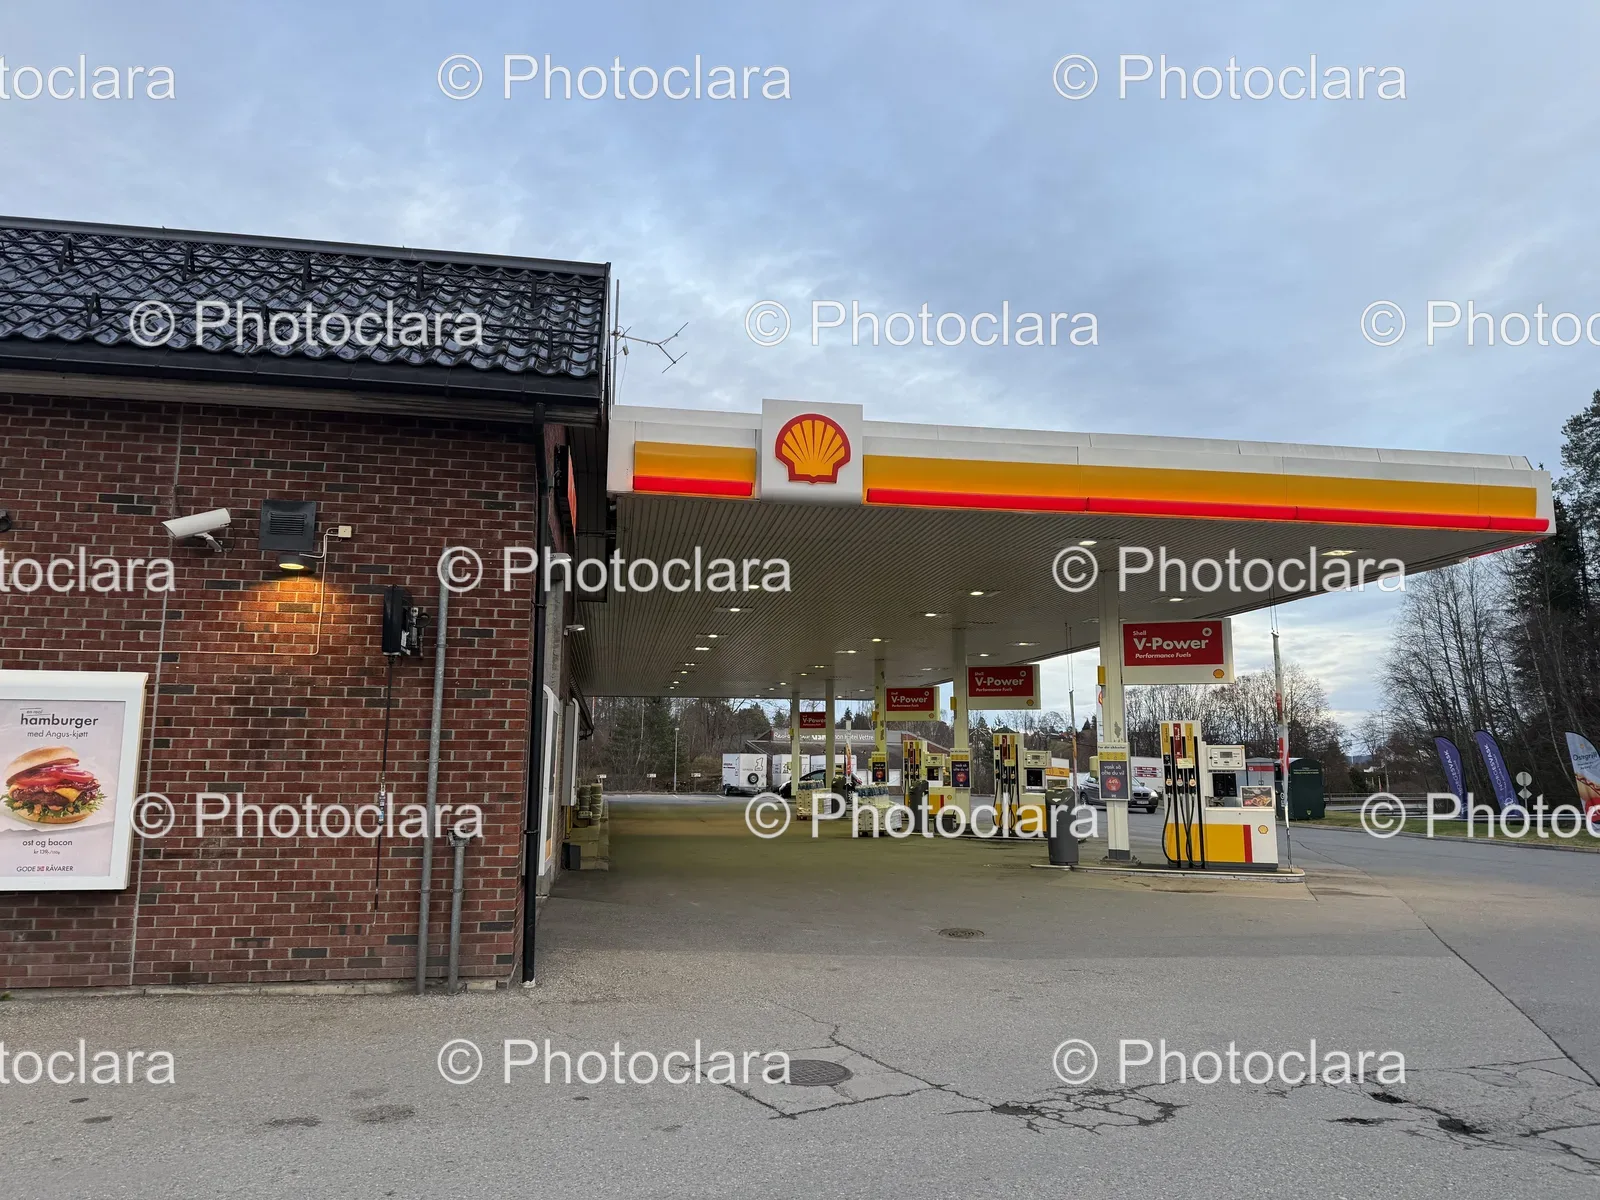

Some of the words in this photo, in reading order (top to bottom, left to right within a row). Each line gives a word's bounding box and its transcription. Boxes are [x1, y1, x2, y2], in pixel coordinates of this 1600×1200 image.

[1133, 637, 1209, 651] V-Power
[974, 677, 1025, 686] V-Power
[891, 695, 928, 703] V-Power
[20, 713, 99, 729] hamburger
[27, 730, 44, 738] med
[45, 730, 89, 740] Angus-kjøtt
[35, 840, 46, 848] og
[48, 838, 73, 846] bacon
[45, 864, 74, 872] RÅVARER
